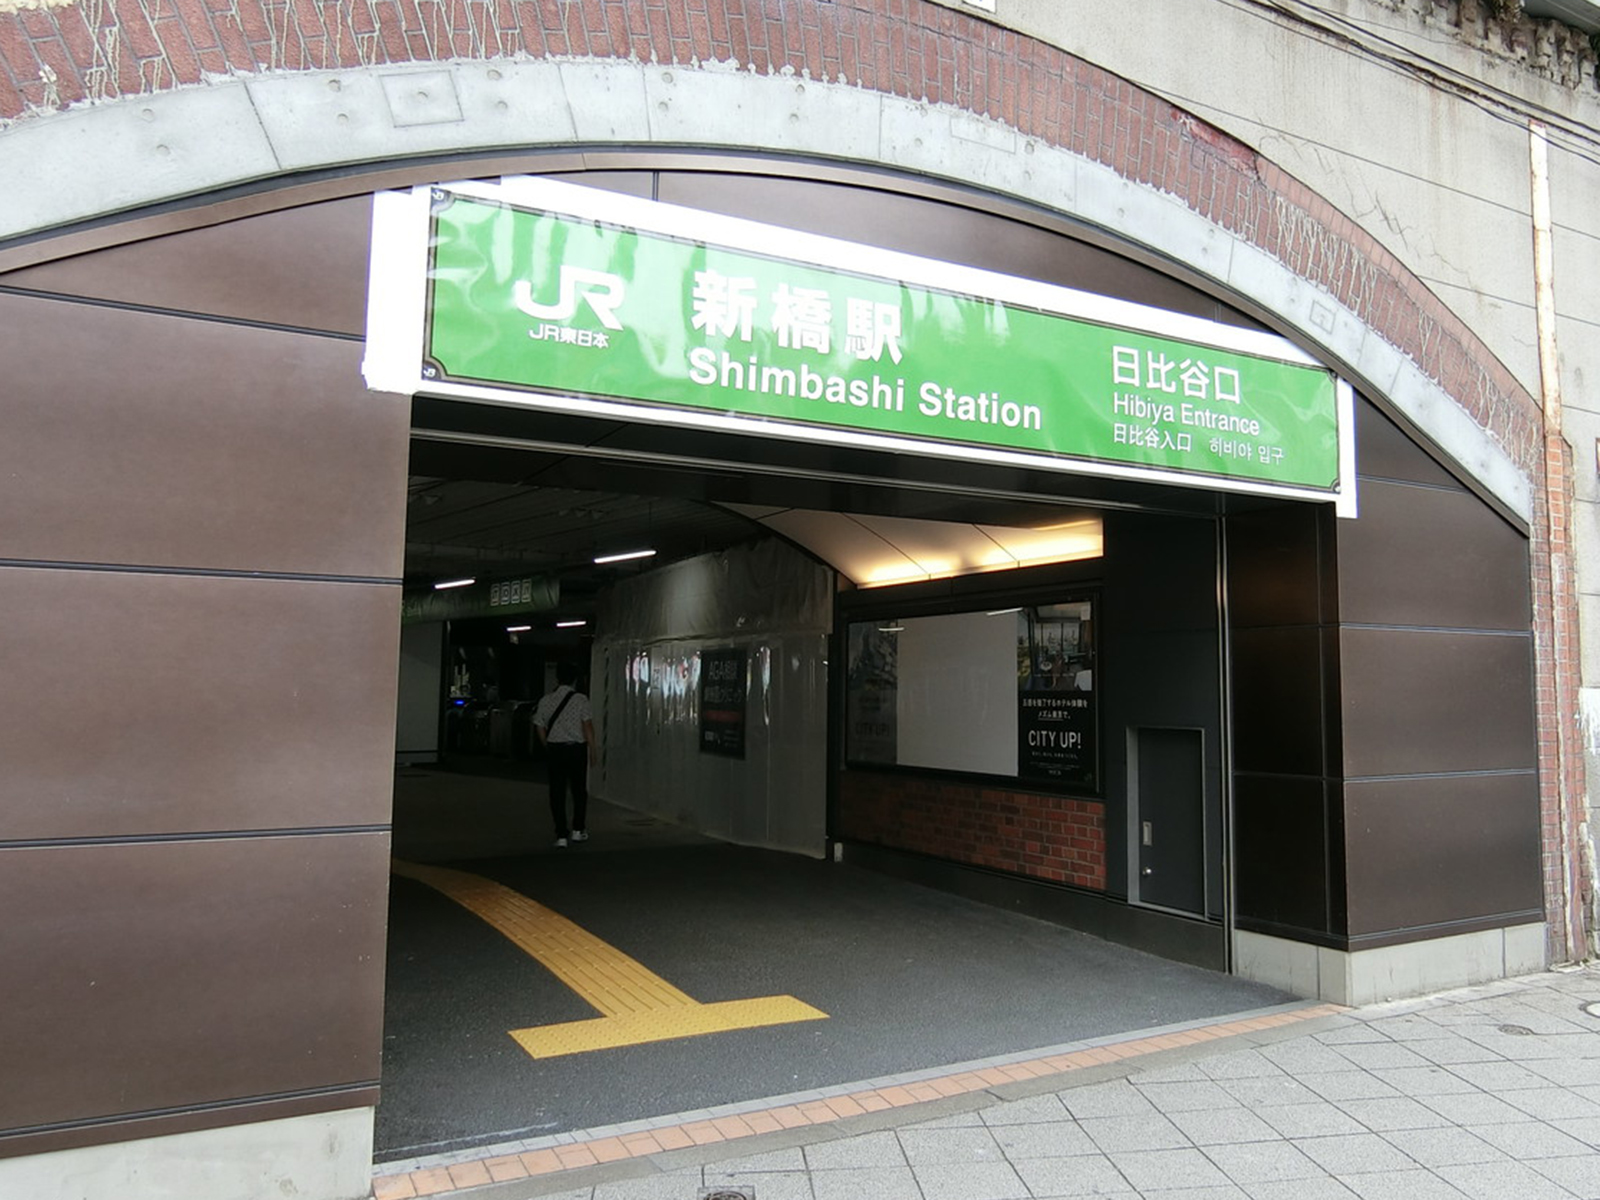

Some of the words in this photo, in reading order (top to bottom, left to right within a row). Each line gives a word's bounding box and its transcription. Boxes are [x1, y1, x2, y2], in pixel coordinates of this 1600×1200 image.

[515, 265, 626, 331] JR
[691, 268, 904, 366] 新橋駅
[529, 324, 610, 350] JR東日本
[689, 347, 905, 413] Shimbashi
[919, 381, 1042, 431] Station
[1112, 345, 1242, 405] 日比谷口
[1113, 392, 1174, 425] Hibiya
[1181, 402, 1260, 437] Entrance
[1113, 423, 1192, 453] 日比谷入口
[1208, 436, 1253, 463] 히비야
[1258, 445, 1285, 466] 입구
[1028, 729, 1057, 748] CITY
[1059, 731, 1082, 750] UP!
